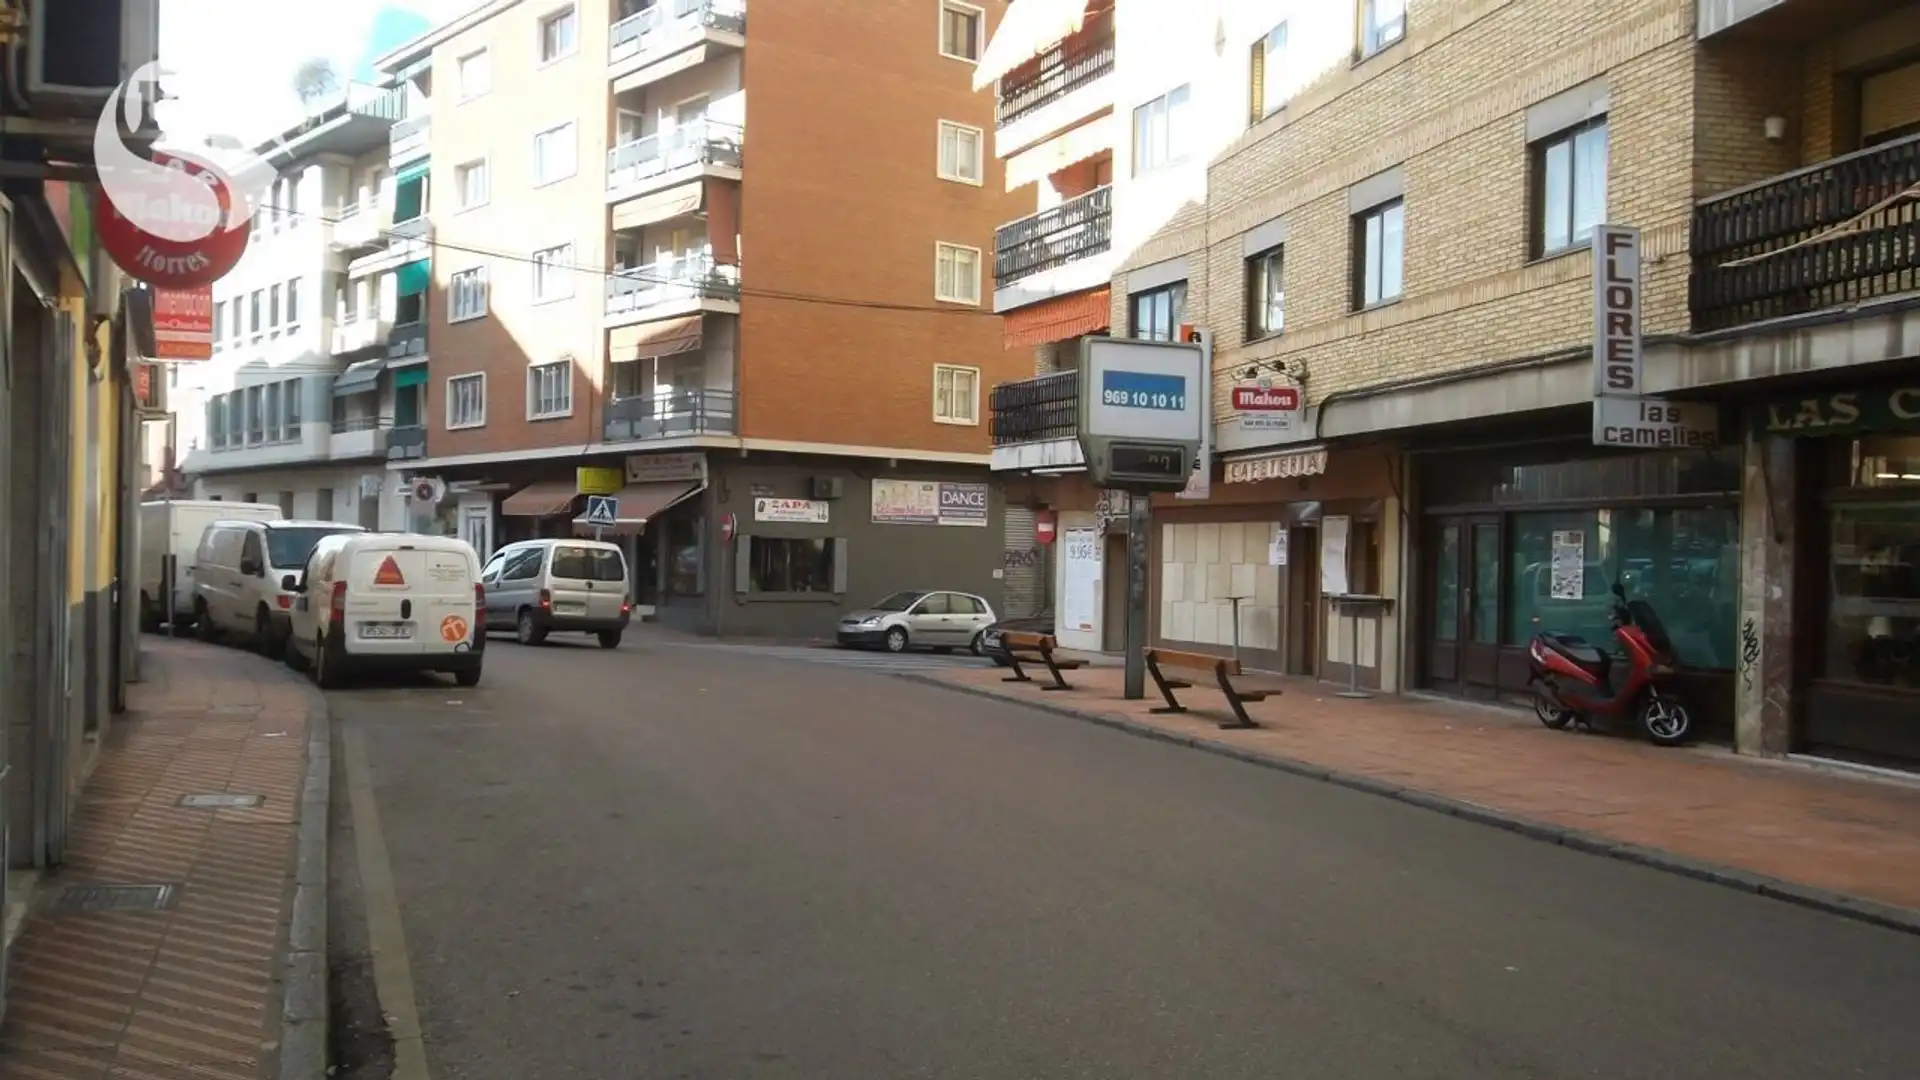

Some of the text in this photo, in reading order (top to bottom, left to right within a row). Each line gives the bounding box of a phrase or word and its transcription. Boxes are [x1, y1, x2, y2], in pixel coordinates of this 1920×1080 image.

[1605, 232, 1634, 390] FLORES
[1104, 389, 1185, 409] 969 10 10 11
[1239, 391, 1293, 406] Mahou
[1639, 402, 1681, 423] las
[1765, 392, 1861, 431] LAS
[1603, 425, 1717, 447] camelias
[1231, 455, 1319, 481] CAFETERIA
[941, 490, 985, 506] DANCE
